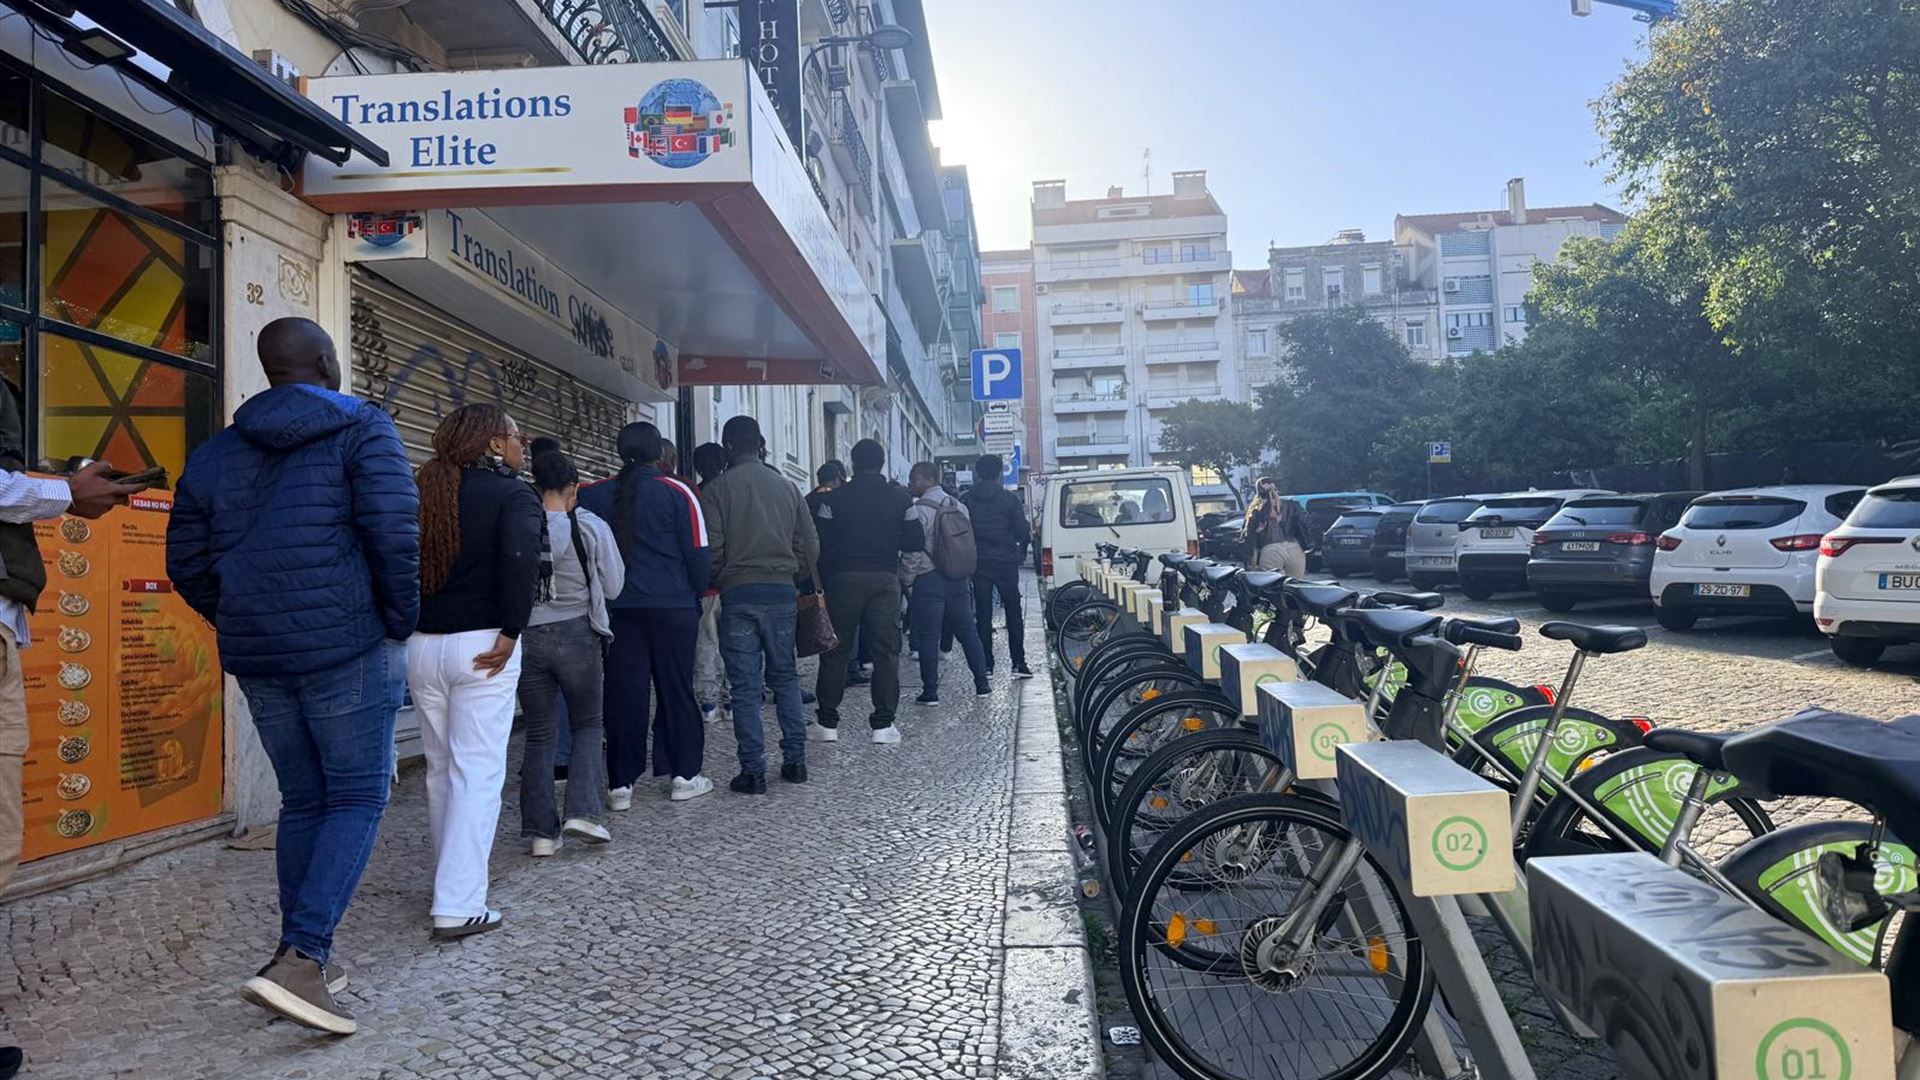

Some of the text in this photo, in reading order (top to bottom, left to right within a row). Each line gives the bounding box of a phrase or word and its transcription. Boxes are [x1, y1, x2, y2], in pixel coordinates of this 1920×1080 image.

[332, 87, 572, 124] Translations
[410, 135, 497, 168] Elite
[446, 208, 561, 318] Translation
[247, 282, 264, 305] 32
[982, 353, 1012, 396] P
[146, 582, 157, 590] BOX
[1320, 735, 1340, 749] 03
[1446, 833, 1473, 851] 02
[1781, 1048, 1826, 1080] 01
